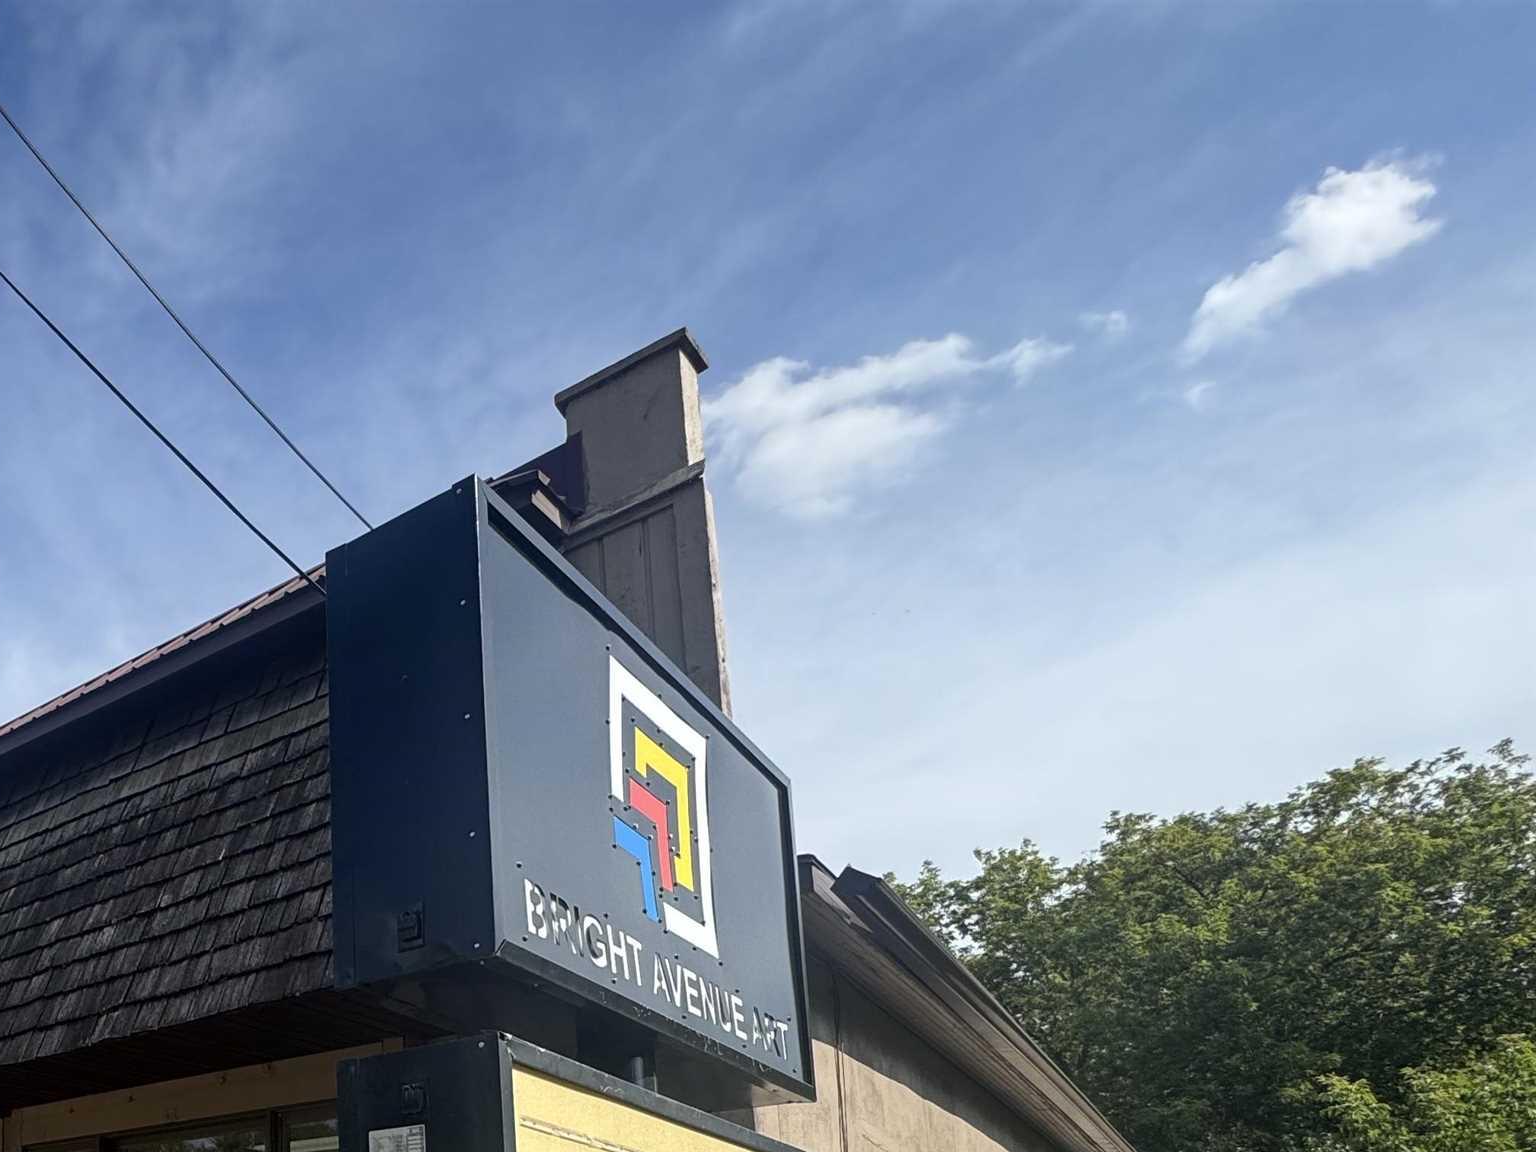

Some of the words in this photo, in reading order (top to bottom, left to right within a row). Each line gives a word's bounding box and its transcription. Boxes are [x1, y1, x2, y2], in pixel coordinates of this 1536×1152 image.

[524, 877, 642, 986] BRIGHT
[653, 952, 748, 1040] AVENUE
[752, 1006, 788, 1060] ART
